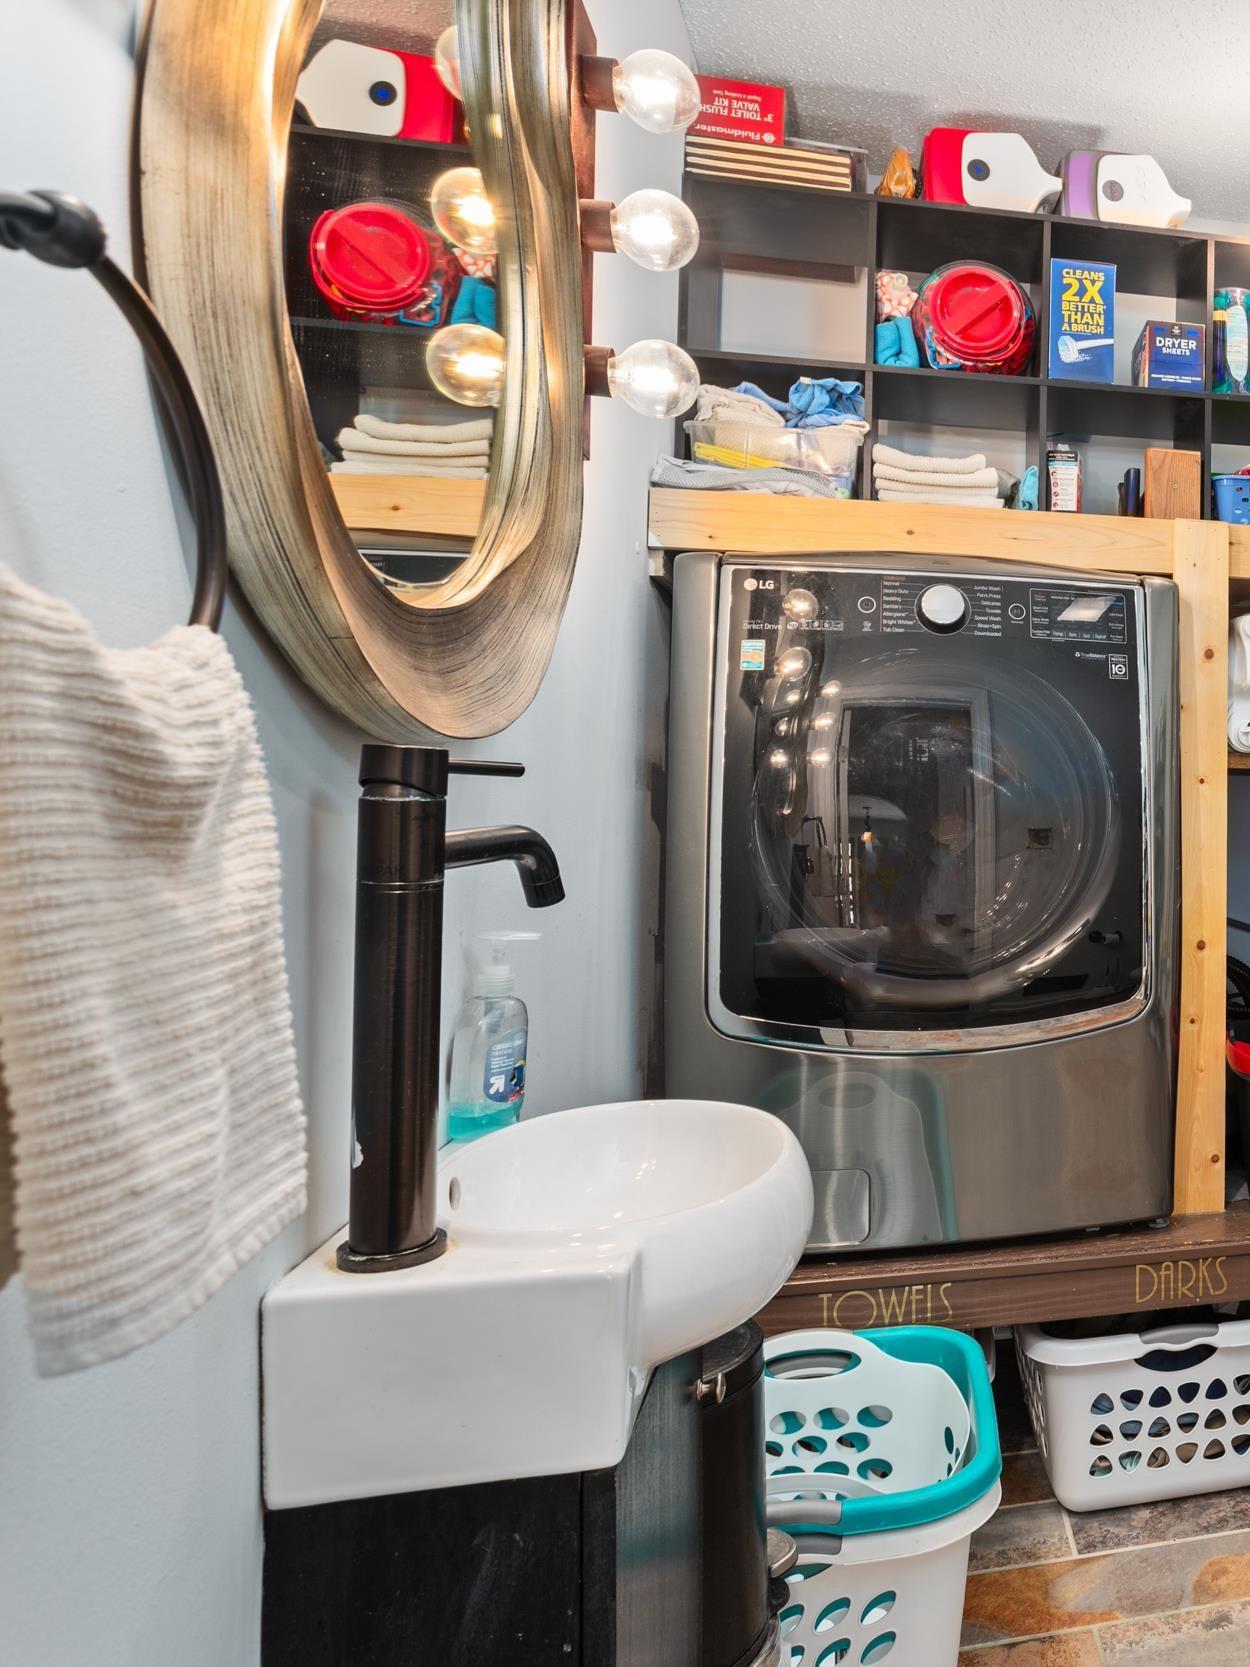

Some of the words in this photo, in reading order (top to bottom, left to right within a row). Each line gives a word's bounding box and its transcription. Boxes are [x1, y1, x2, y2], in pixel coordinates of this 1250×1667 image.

[713, 96, 729, 107] KIT
[731, 99, 760, 112] VALVE
[699, 103, 729, 116] FLUSH
[731, 107, 762, 121] TOILET
[695, 123, 761, 141] Fluidmaster
[1062, 268, 1105, 281] CLEANS
[1061, 277, 1104, 305] 2X
[1062, 311, 1105, 326] THAN
[1061, 323, 1070, 331] A
[1071, 324, 1104, 335] BRUSH
[1155, 336, 1197, 350] DRYER
[1161, 347, 1190, 356] SHEETS
[759, 580, 775, 590] LG
[743, 622, 763, 630] Direct
[1135, 1256, 1228, 1304] DARKS
[818, 1282, 953, 1328] TOWELS
